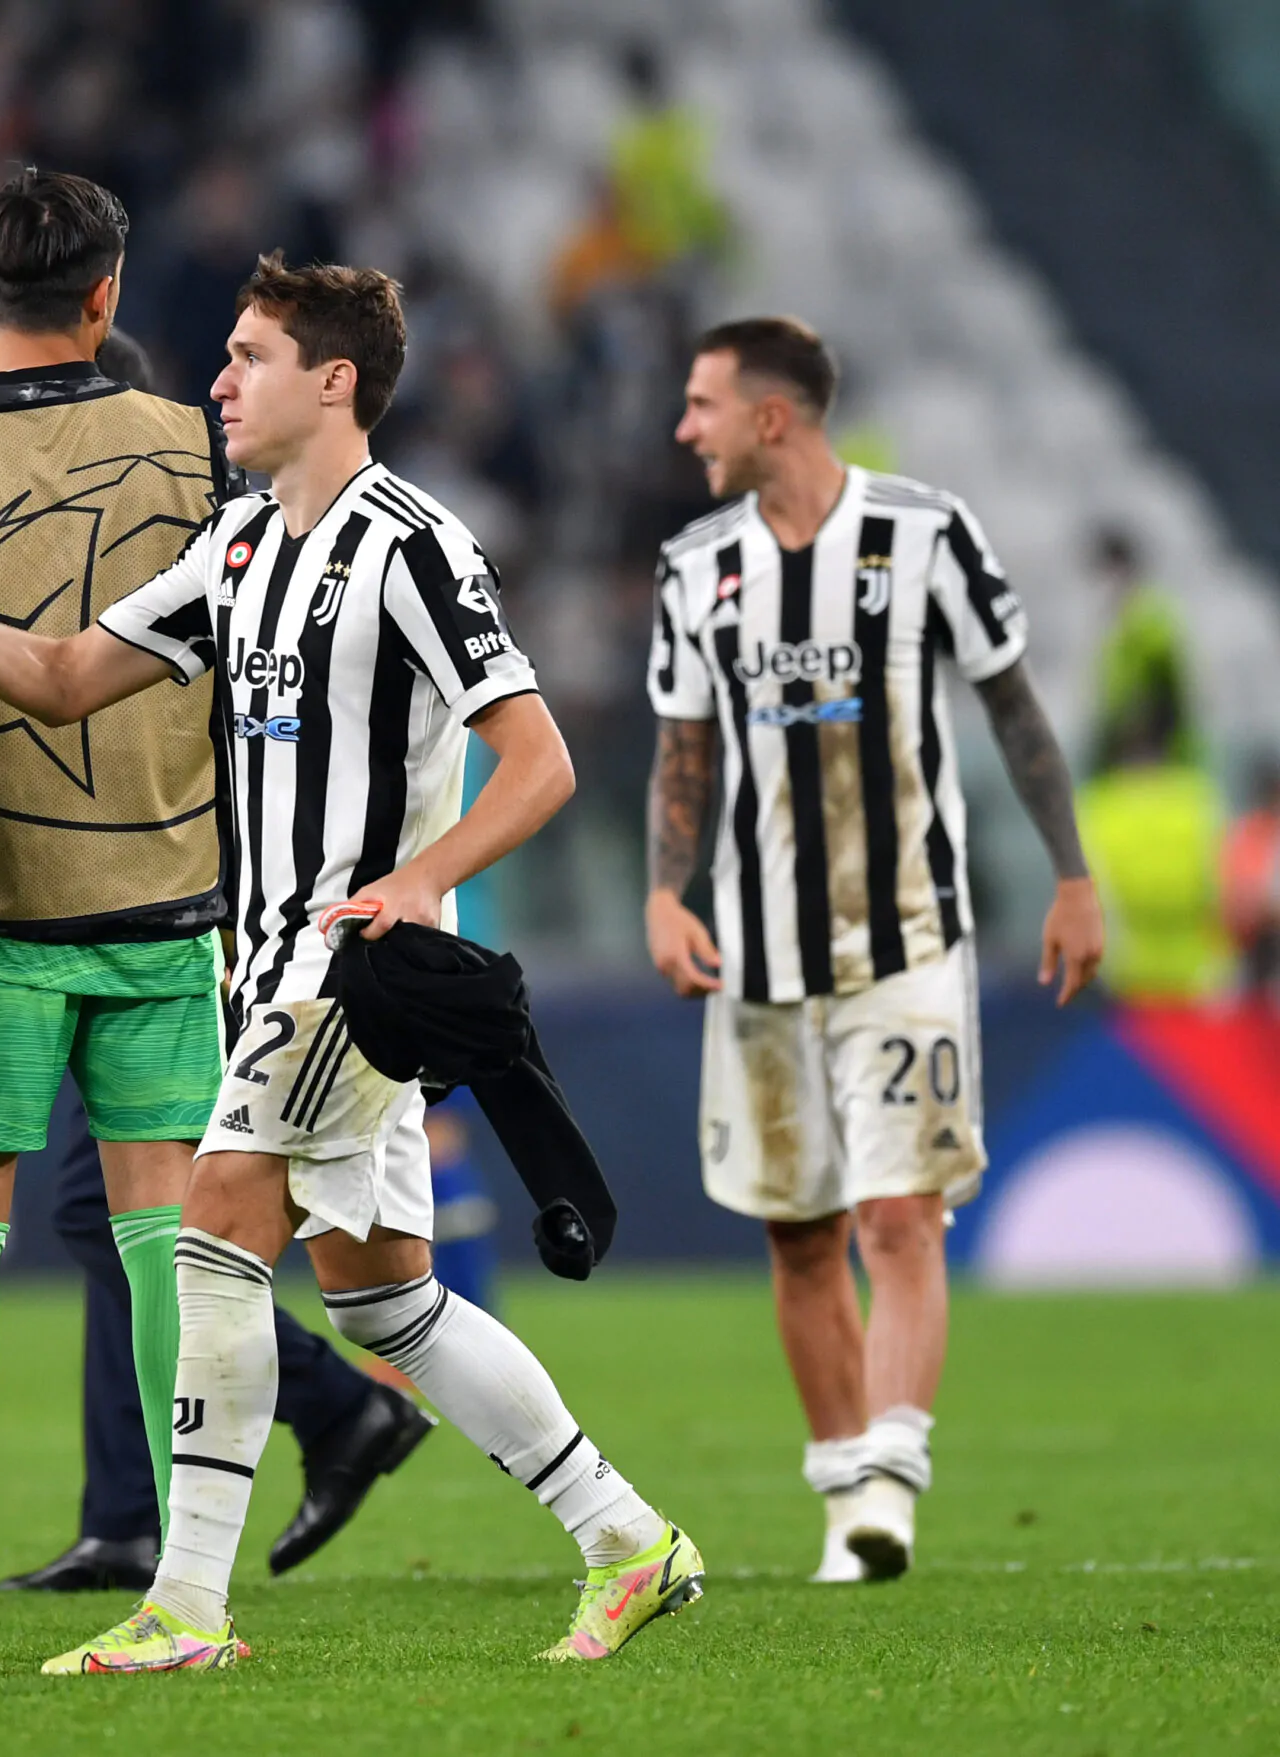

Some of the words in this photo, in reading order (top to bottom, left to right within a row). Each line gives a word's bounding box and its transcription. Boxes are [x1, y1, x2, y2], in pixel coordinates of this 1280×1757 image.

[228, 637, 303, 697] Jeep
[464, 631, 517, 660] Bitg
[735, 638, 861, 682] Jeep
[882, 1036, 960, 1106] 20
